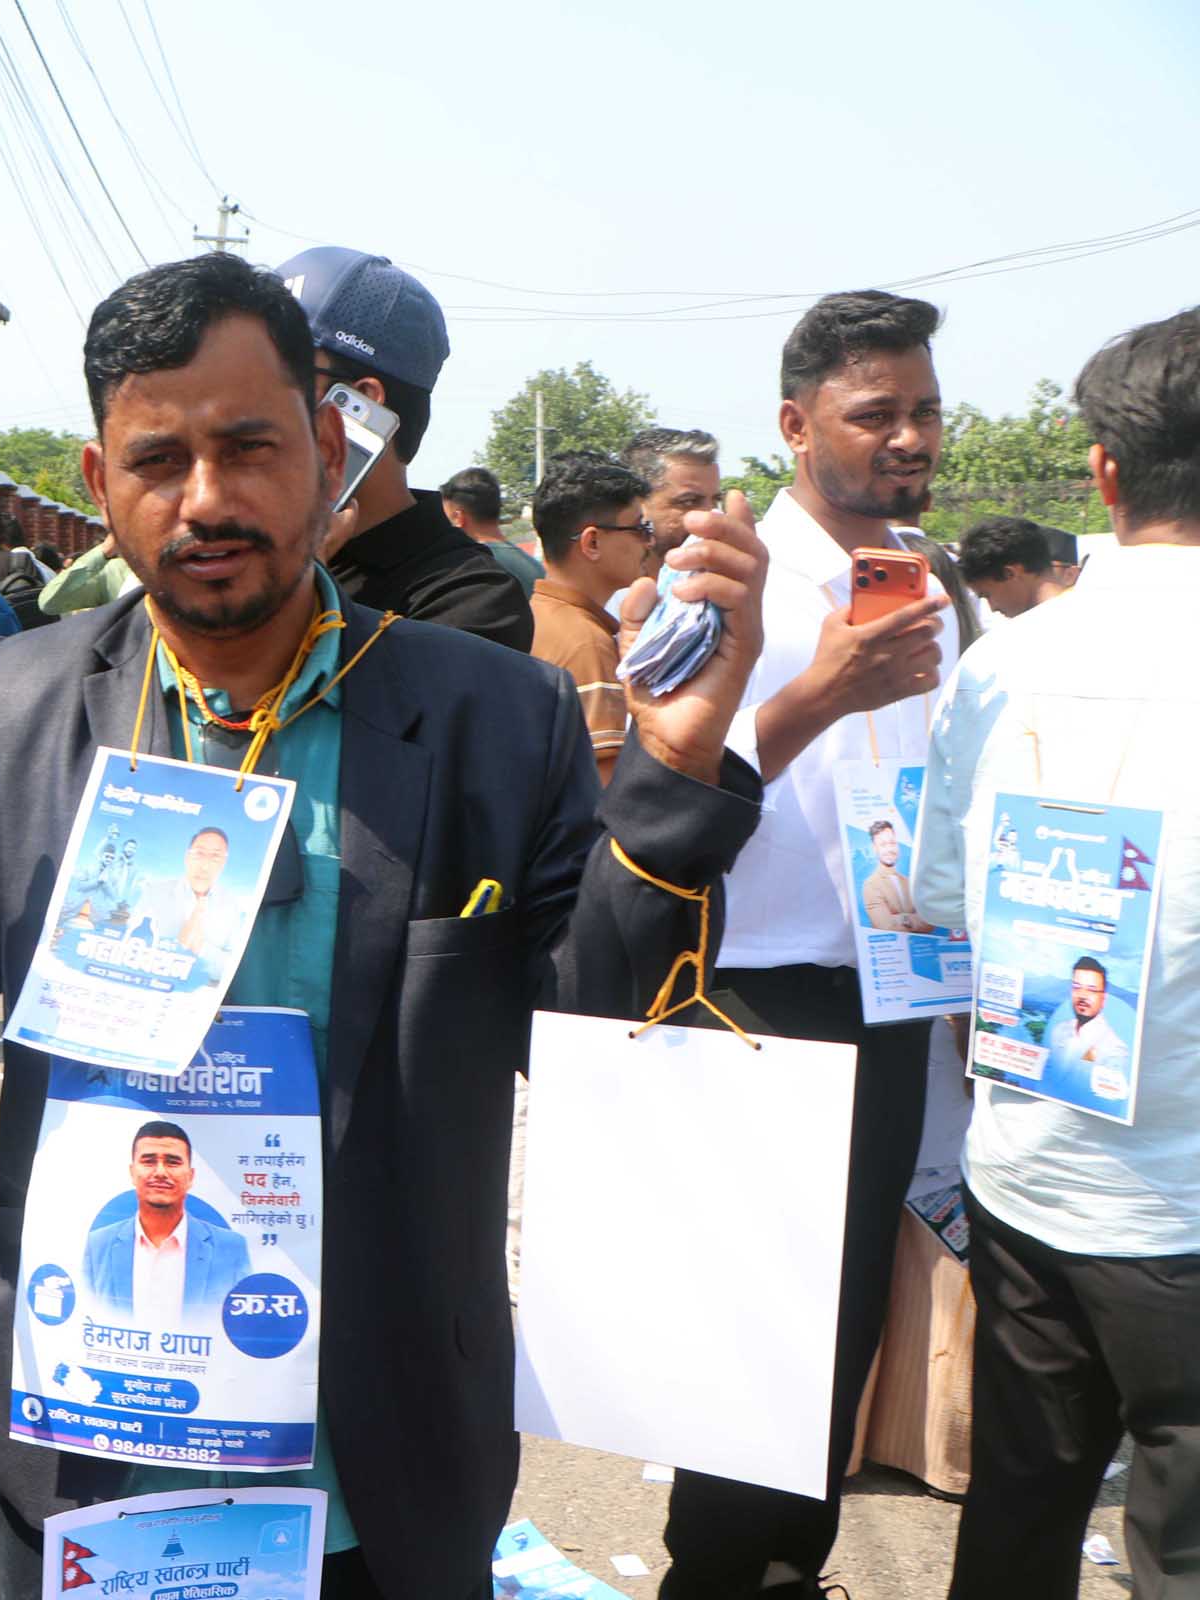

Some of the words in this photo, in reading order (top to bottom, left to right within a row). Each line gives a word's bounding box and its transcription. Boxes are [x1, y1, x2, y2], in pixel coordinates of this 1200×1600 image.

[335, 330, 377, 357] adidas
[243, 1173, 268, 1188] पद
[240, 1191, 301, 1206] जिम्मेवारी
[82, 1315, 152, 1351] हेमराज
[160, 1333, 213, 1356] थापा
[112, 1437, 222, 1463] 9848753882
[101, 1570, 150, 1596] राष्ट्रिय
[154, 1563, 211, 1585] स्वतन्त्र
[216, 1556, 251, 1577] पार्टी
[182, 1585, 236, 1600] ऐतिहासिक
